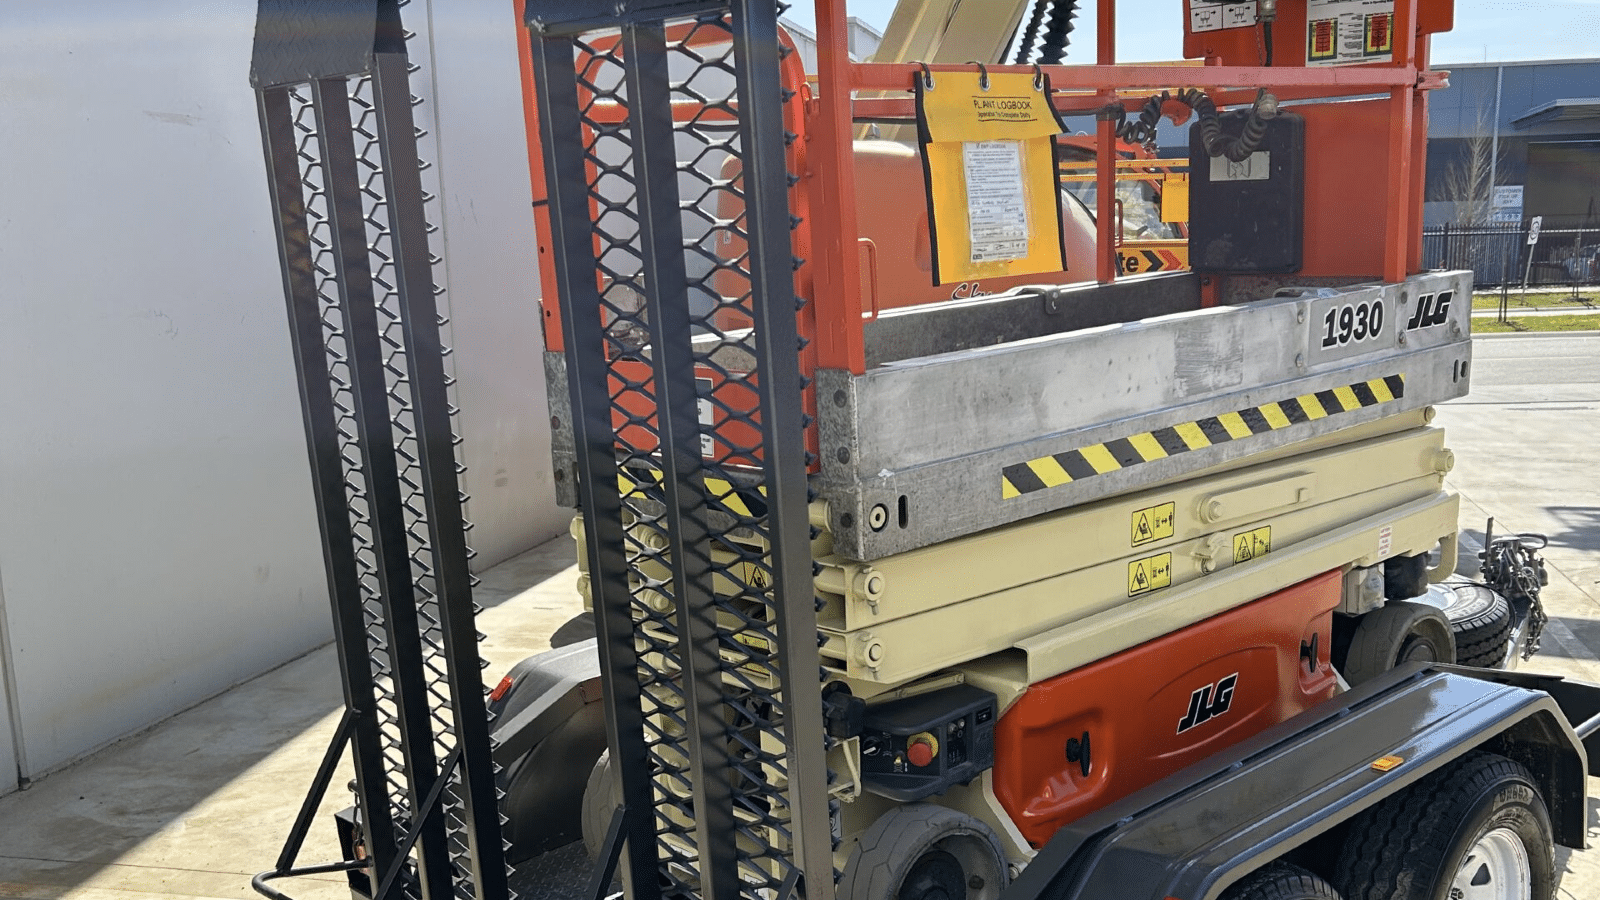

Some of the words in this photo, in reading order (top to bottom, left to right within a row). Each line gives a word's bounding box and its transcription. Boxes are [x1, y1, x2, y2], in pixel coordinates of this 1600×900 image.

[973, 99, 996, 109] PLANT
[997, 100, 1033, 110] LOGBOOK
[1321, 298, 1384, 350] 1930
[1406, 289, 1454, 332] JLG
[1176, 672, 1239, 735] JLG
